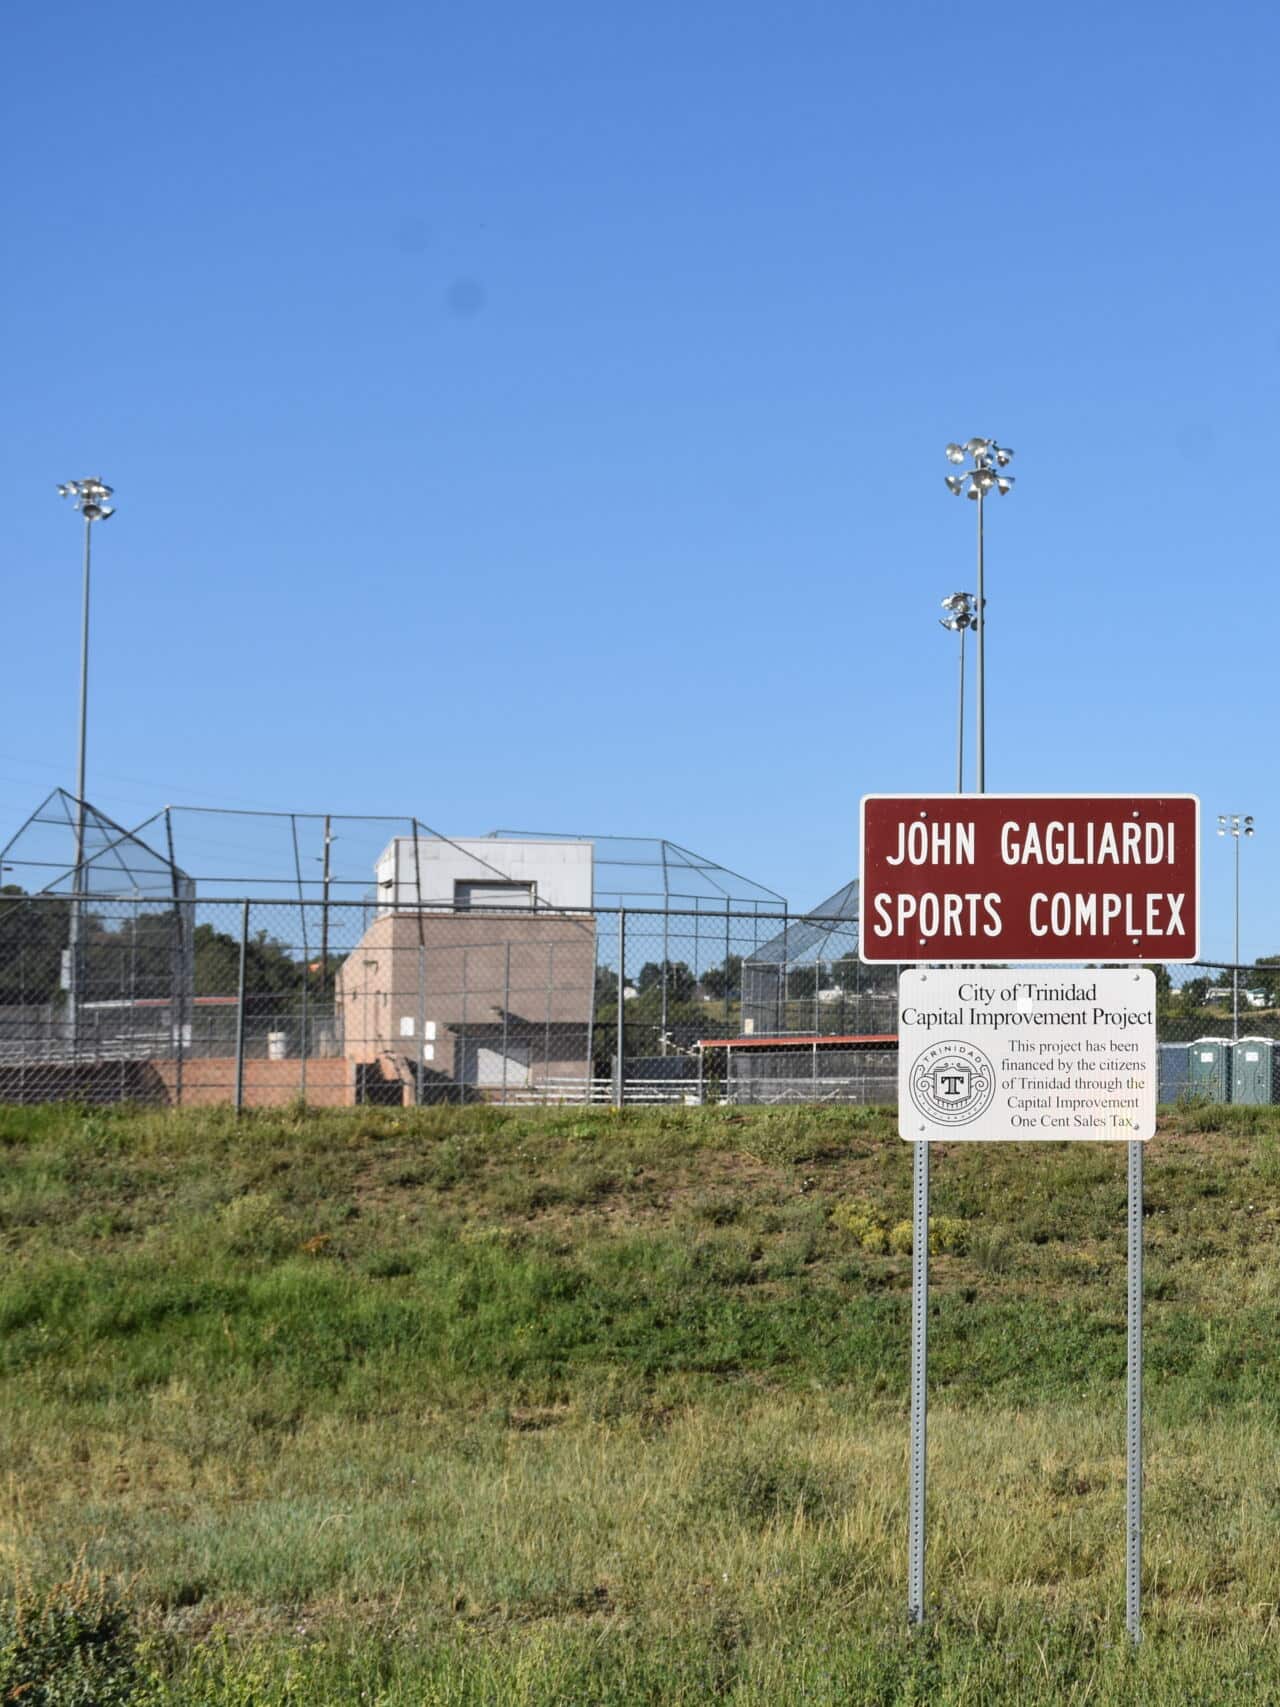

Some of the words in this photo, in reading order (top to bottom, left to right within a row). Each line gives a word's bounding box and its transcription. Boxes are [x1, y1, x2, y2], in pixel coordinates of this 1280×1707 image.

[886, 822, 974, 865] JOHN
[1001, 821, 1174, 865] GAGLIARDI
[874, 893, 1001, 936] SPORTS
[1030, 893, 1185, 936] COMPLEX
[958, 984, 995, 1006] City
[1001, 984, 1019, 1001] of
[1023, 984, 1096, 1001] Trinidad
[902, 1008, 962, 1030] Capital
[971, 1008, 1087, 1030] Improvement
[1094, 1008, 1152, 1030] Project
[922, 1045, 983, 1064] TRINIDAD
[1008, 1040, 1035, 1052] This
[1040, 1040, 1080, 1055] project
[1086, 1040, 1106, 1051] has
[1110, 1040, 1138, 1051] been
[1002, 1058, 1053, 1071] financed
[1058, 1059, 1073, 1073] by
[1077, 1058, 1095, 1070] the
[1100, 1059, 1146, 1070] citizens
[1002, 1077, 1016, 1089] of
[1018, 1077, 1070, 1089] Trinidad
[1075, 1077, 1122, 1092] through
[1127, 1077, 1144, 1089] the
[1008, 1096, 1051, 1111] Capital
[1057, 1096, 1138, 1111] Improvement
[1011, 1115, 1036, 1127] One
[1041, 1115, 1069, 1127] Cent
[1074, 1115, 1106, 1126] Sales
[1110, 1115, 1132, 1127] Tax
